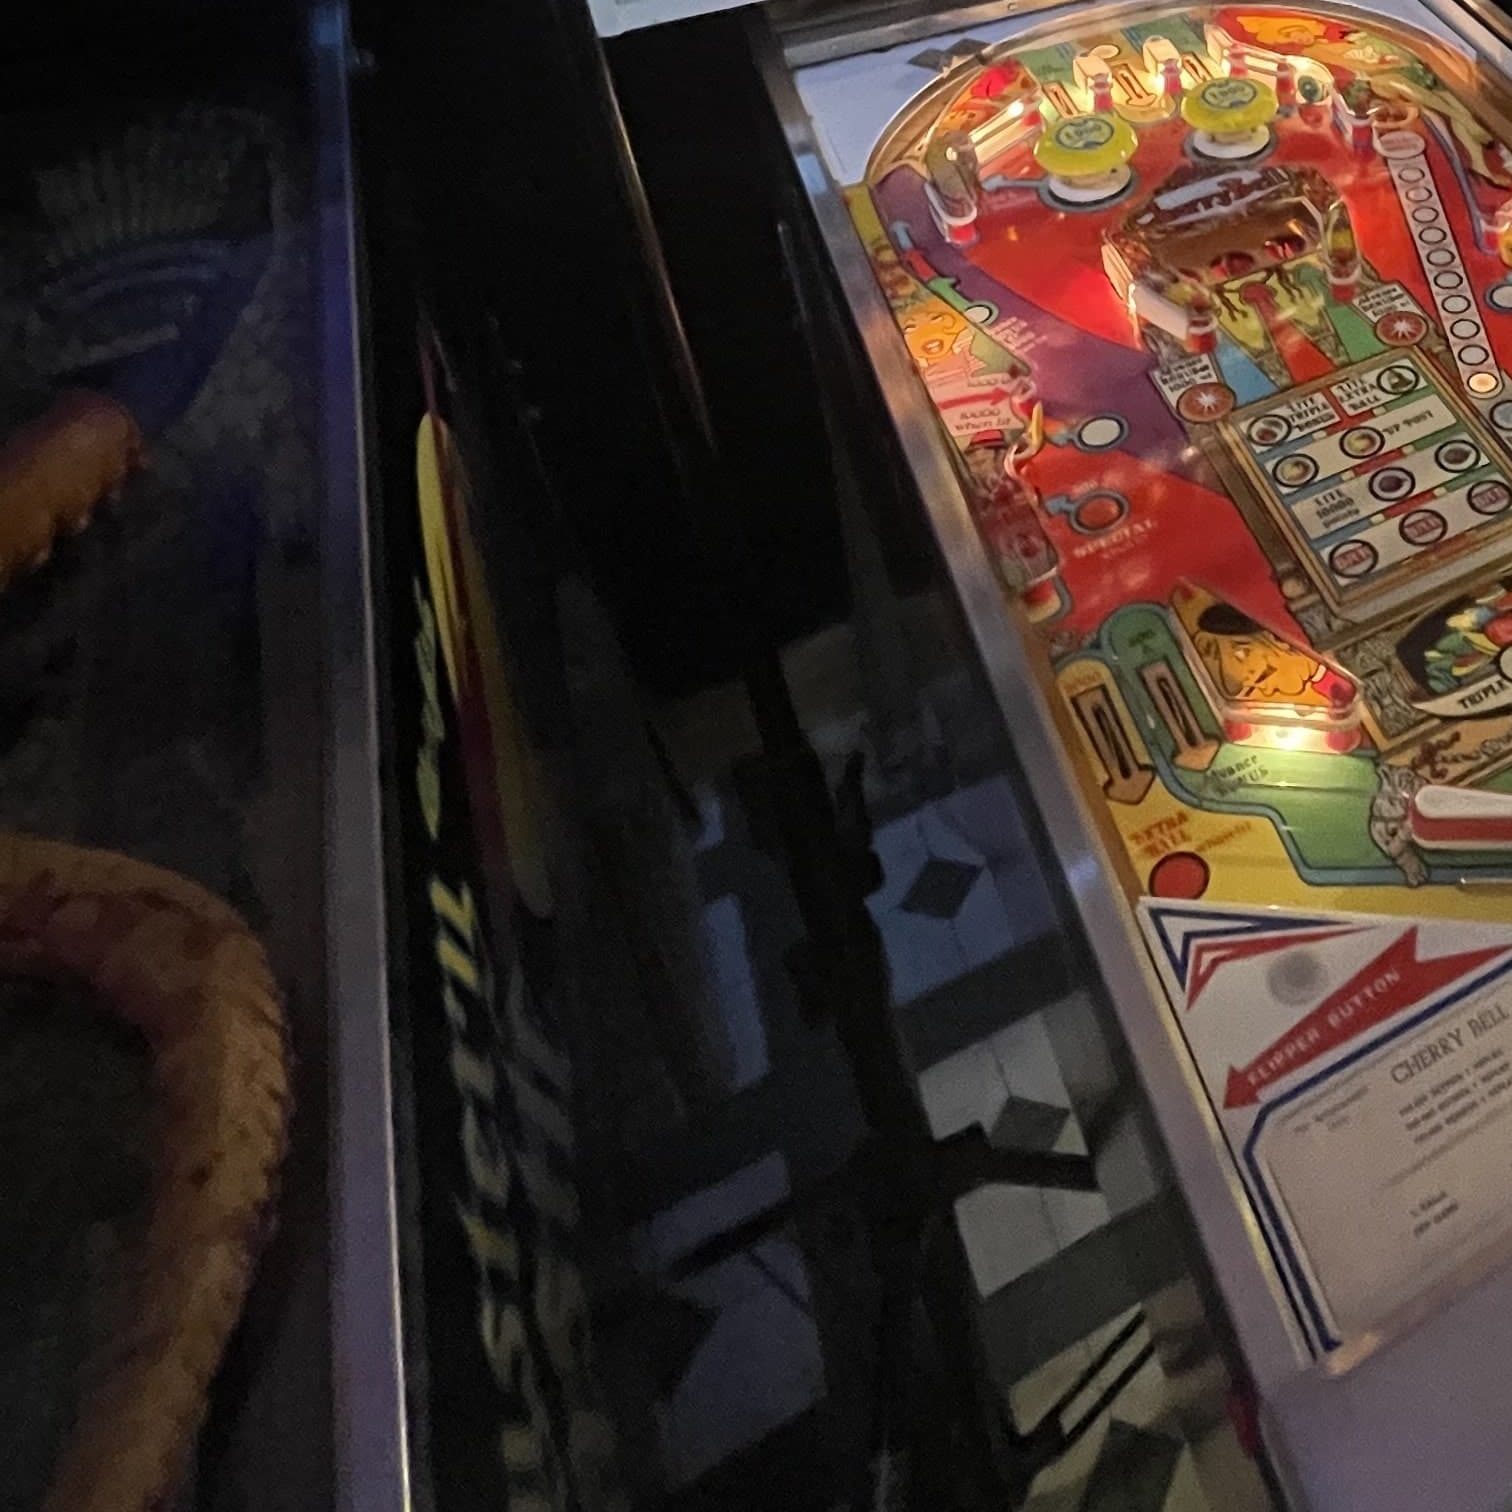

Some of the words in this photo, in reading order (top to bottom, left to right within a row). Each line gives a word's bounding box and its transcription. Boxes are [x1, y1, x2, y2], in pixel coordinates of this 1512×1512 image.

[1247, 1027, 1321, 1086] FLIPPER
[1326, 967, 1400, 1029] BUTTON
[1390, 1027, 1464, 1085] CHERRY
[1466, 1003, 1512, 1039] BELL
